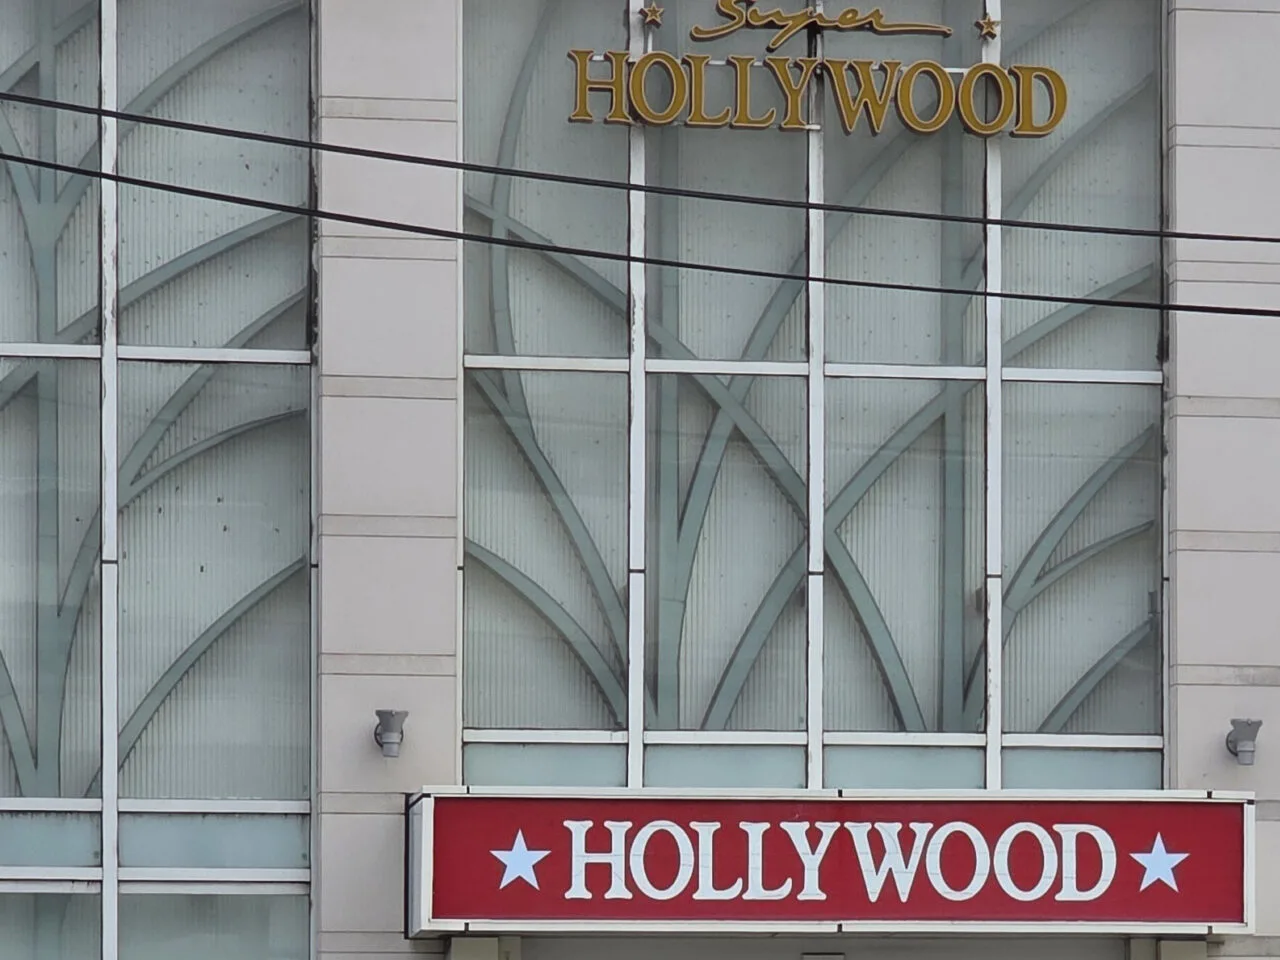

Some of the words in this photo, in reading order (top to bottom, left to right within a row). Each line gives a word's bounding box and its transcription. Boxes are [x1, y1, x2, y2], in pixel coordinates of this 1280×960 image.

[689, 0, 953, 51] Super
[567, 50, 1068, 137] HOLLYWOOD
[563, 820, 1117, 903] HOLLYWOOD
